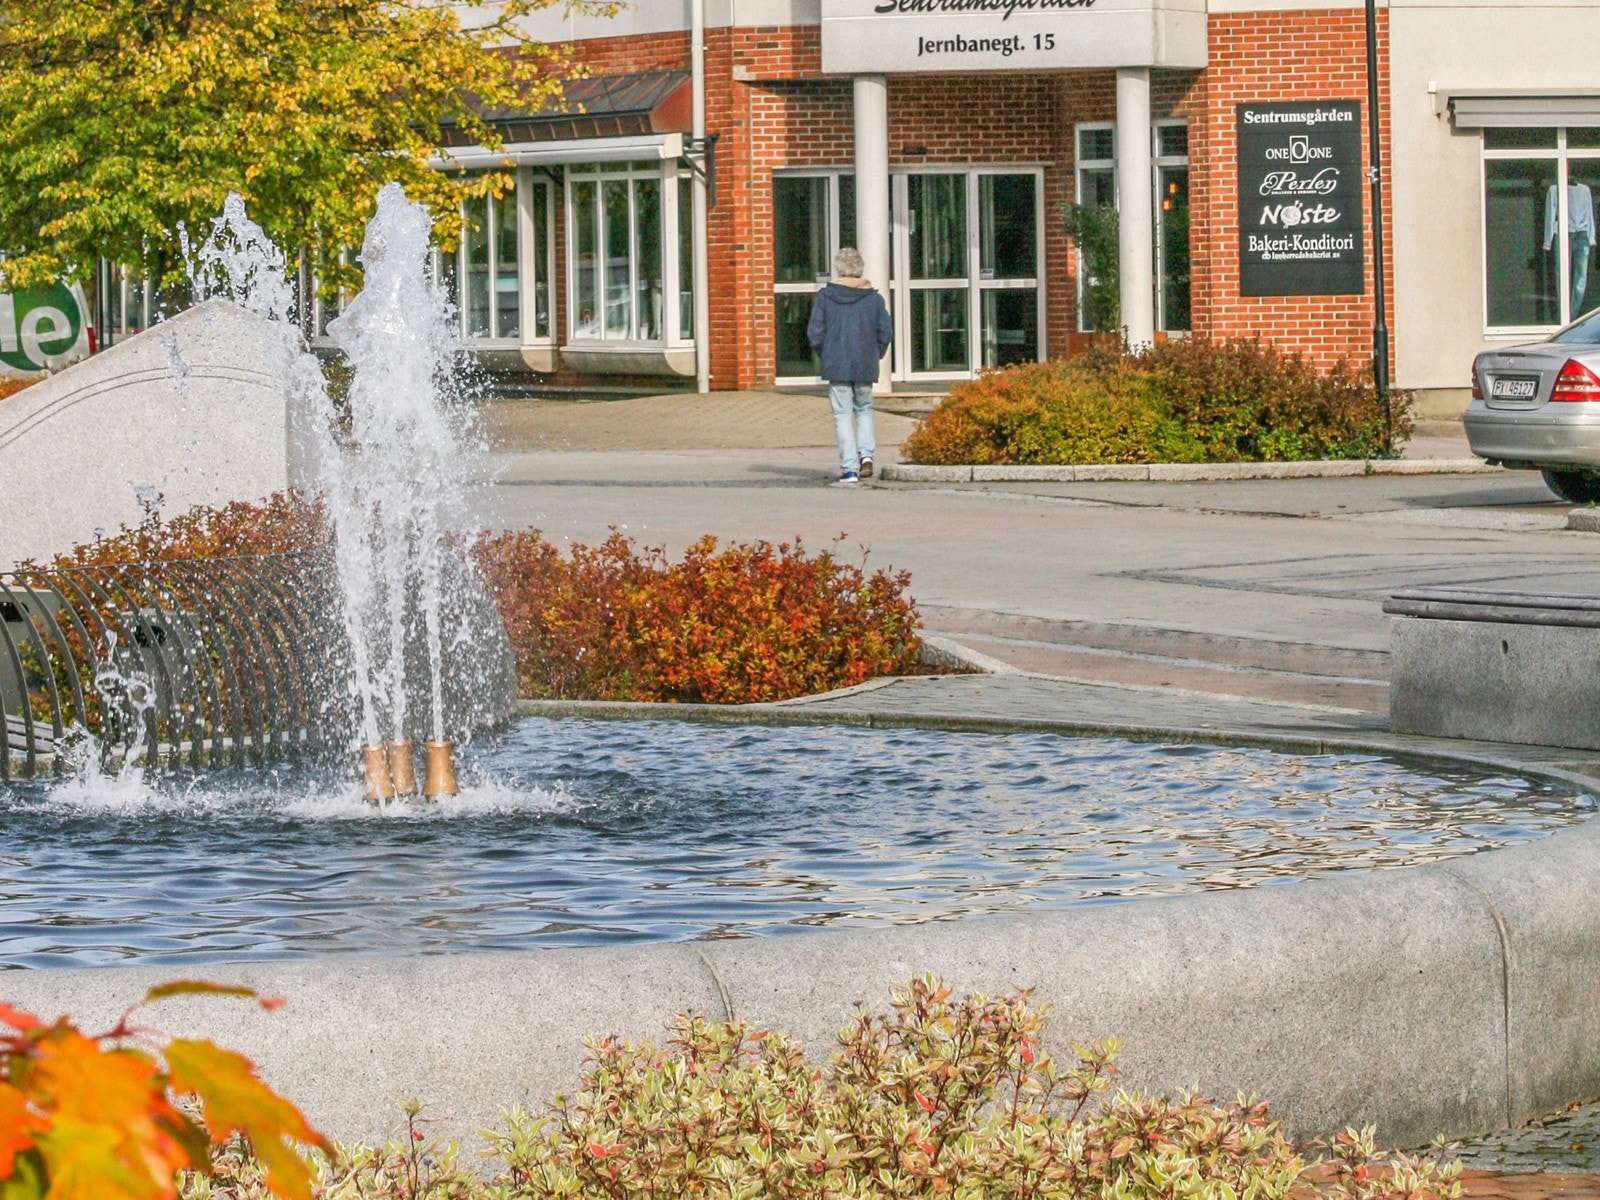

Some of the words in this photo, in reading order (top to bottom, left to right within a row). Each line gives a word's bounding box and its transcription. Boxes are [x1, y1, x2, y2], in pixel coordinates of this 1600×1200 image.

[917, 34, 1026, 57] Jernbanegt.
[1033, 33, 1056, 51] 15
[1244, 108, 1353, 125] Sentrumsgården
[1259, 167, 1340, 196] Perlen
[1249, 234, 1354, 252] Bakeri-Konditori
